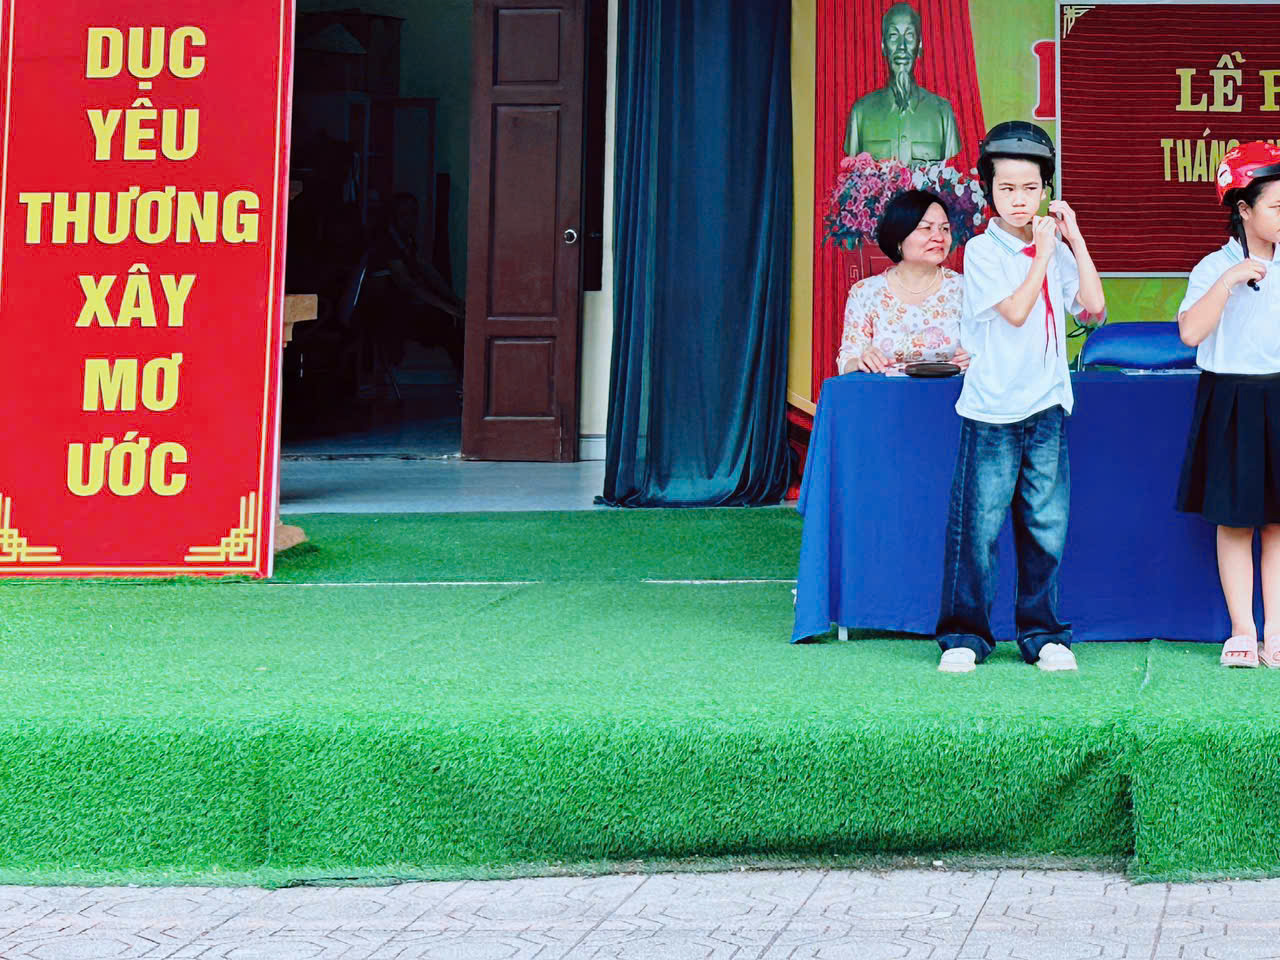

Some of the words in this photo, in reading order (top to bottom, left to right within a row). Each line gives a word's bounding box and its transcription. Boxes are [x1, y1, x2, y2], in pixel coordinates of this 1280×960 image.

[86, 26, 206, 90] DỤC
[1175, 51, 1247, 113] LỄ
[87, 97, 200, 161] YÊU
[1160, 128, 1241, 183] THÁN
[19, 185, 260, 244] THƯƠNG
[75, 263, 196, 328] XÂY
[83, 352, 183, 412] MƠ
[67, 431, 188, 497] ƯỚC
